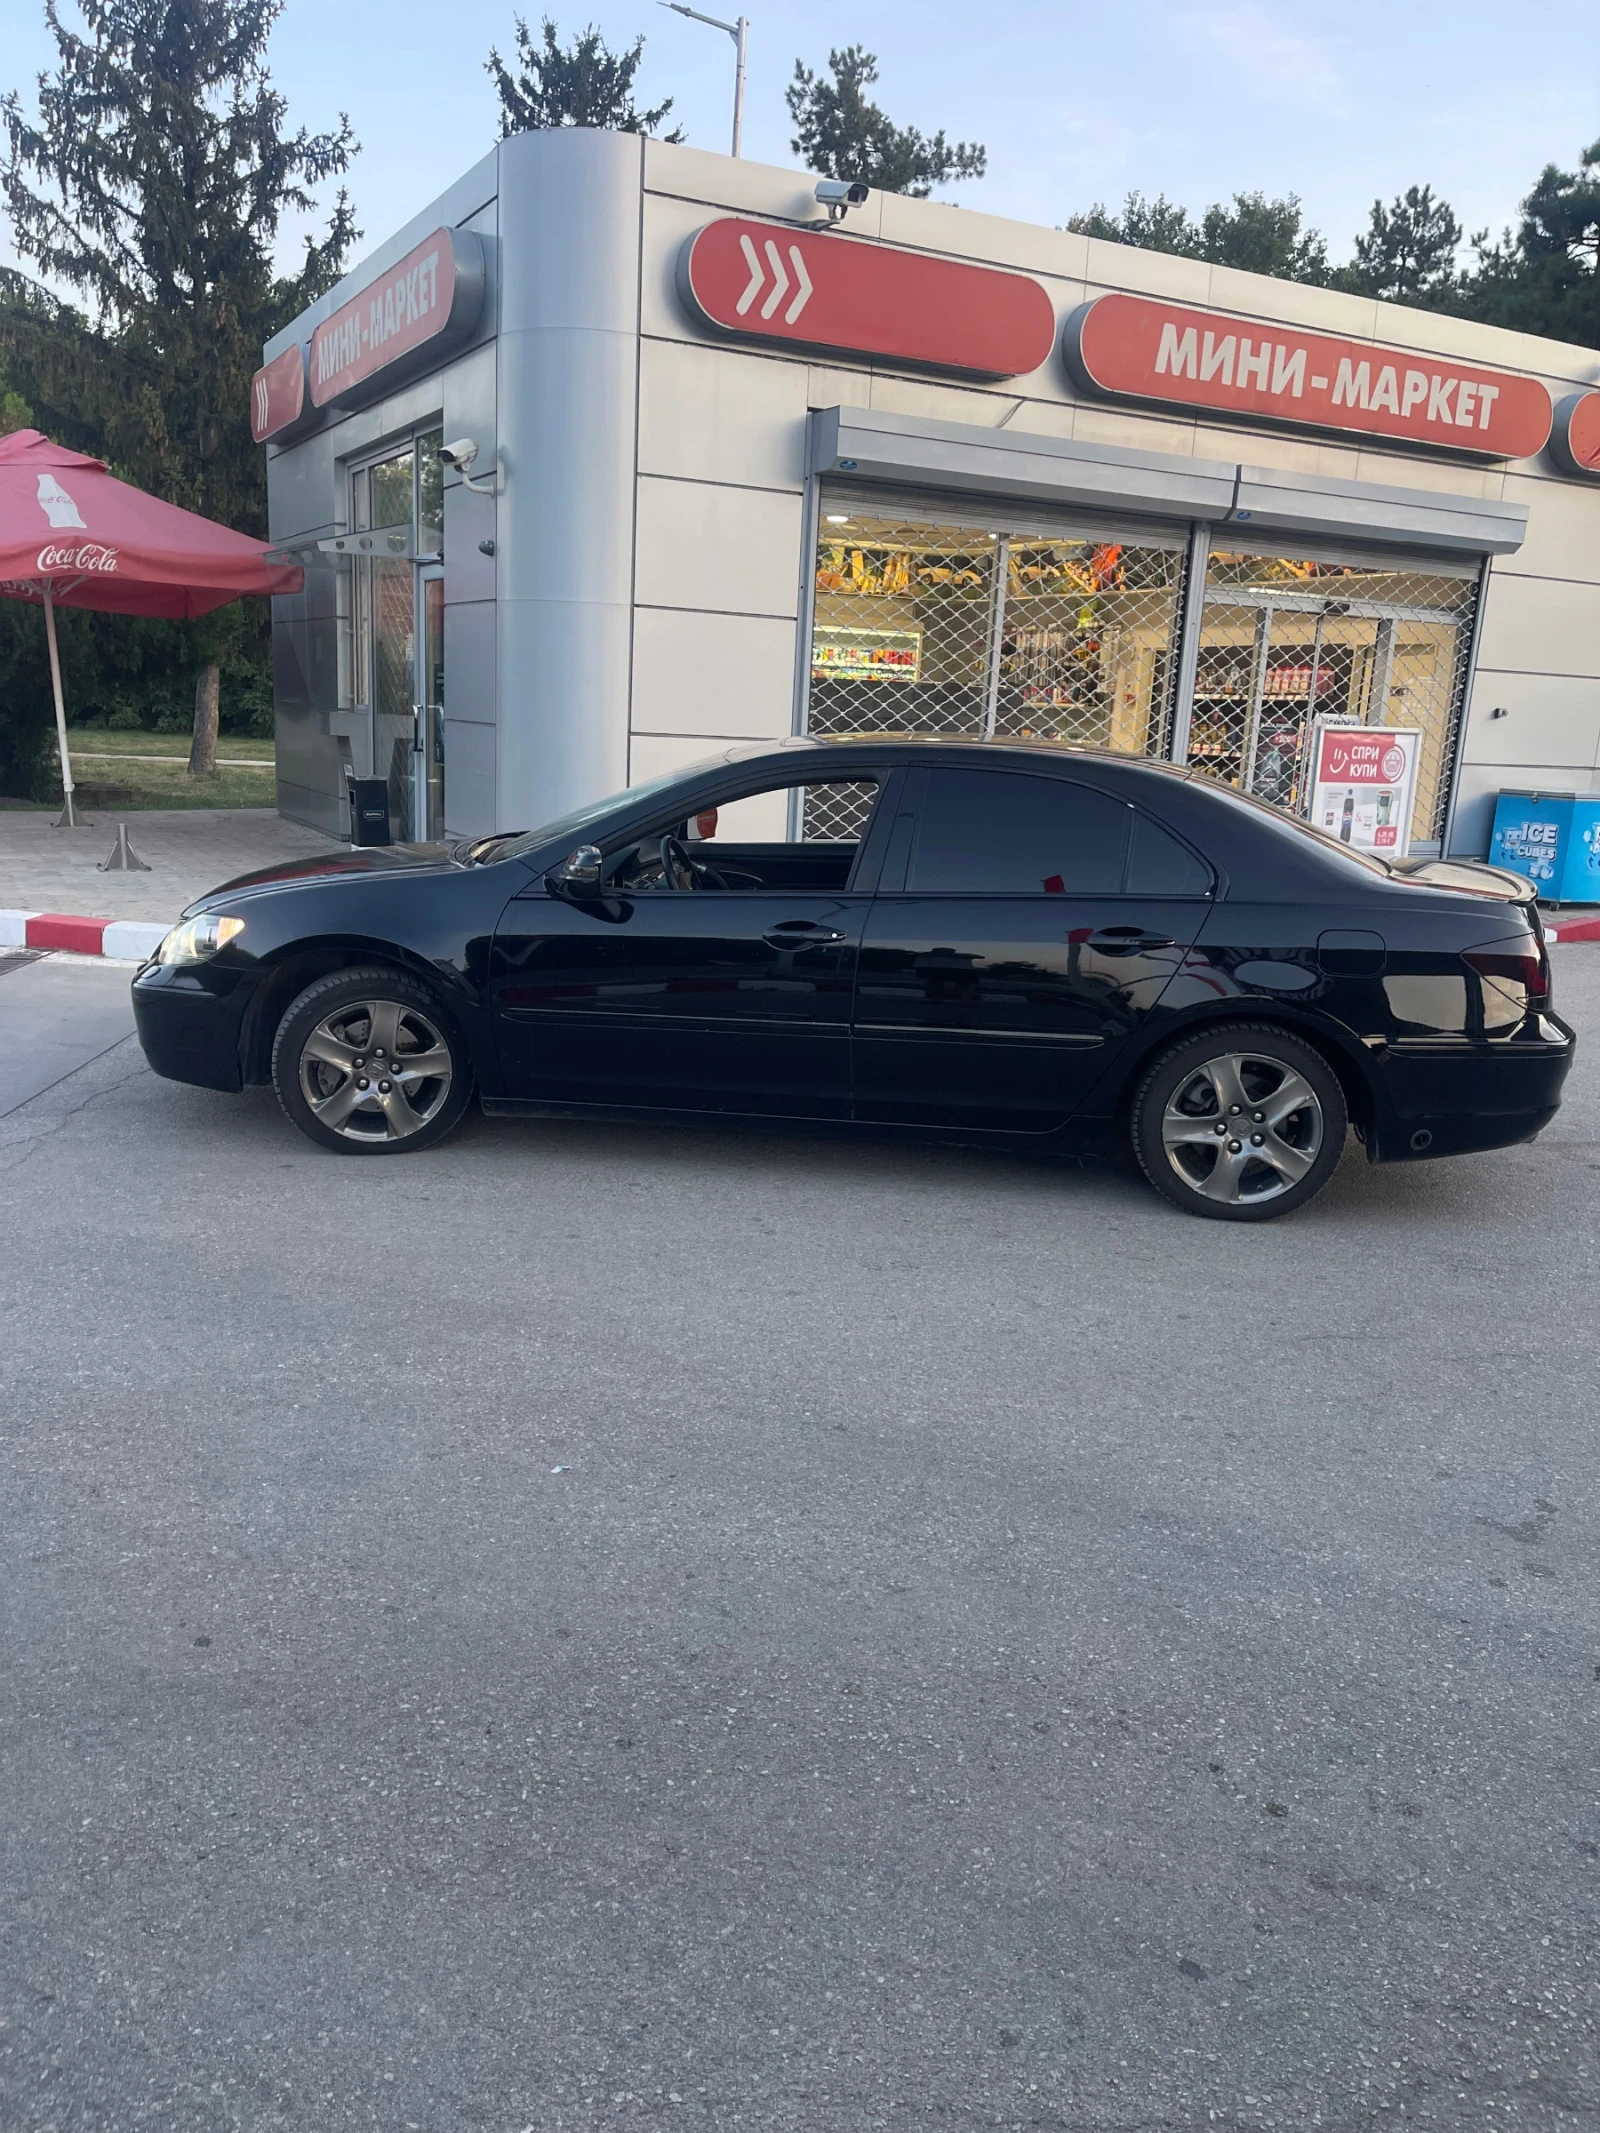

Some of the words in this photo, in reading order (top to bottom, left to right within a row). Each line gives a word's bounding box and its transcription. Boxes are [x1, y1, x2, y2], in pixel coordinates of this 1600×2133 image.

[318, 250, 439, 386] МИНИ-МАРКЕТ
[1154, 322, 1500, 430] МИНИ-МАРКЕТ
[37, 544, 120, 572] Coca-Cola
[1351, 745, 1380, 760] СПРИ
[1349, 763, 1378, 778] КУПИ
[1520, 822, 1558, 845] ICE
[1517, 846, 1556, 861] CUBES
